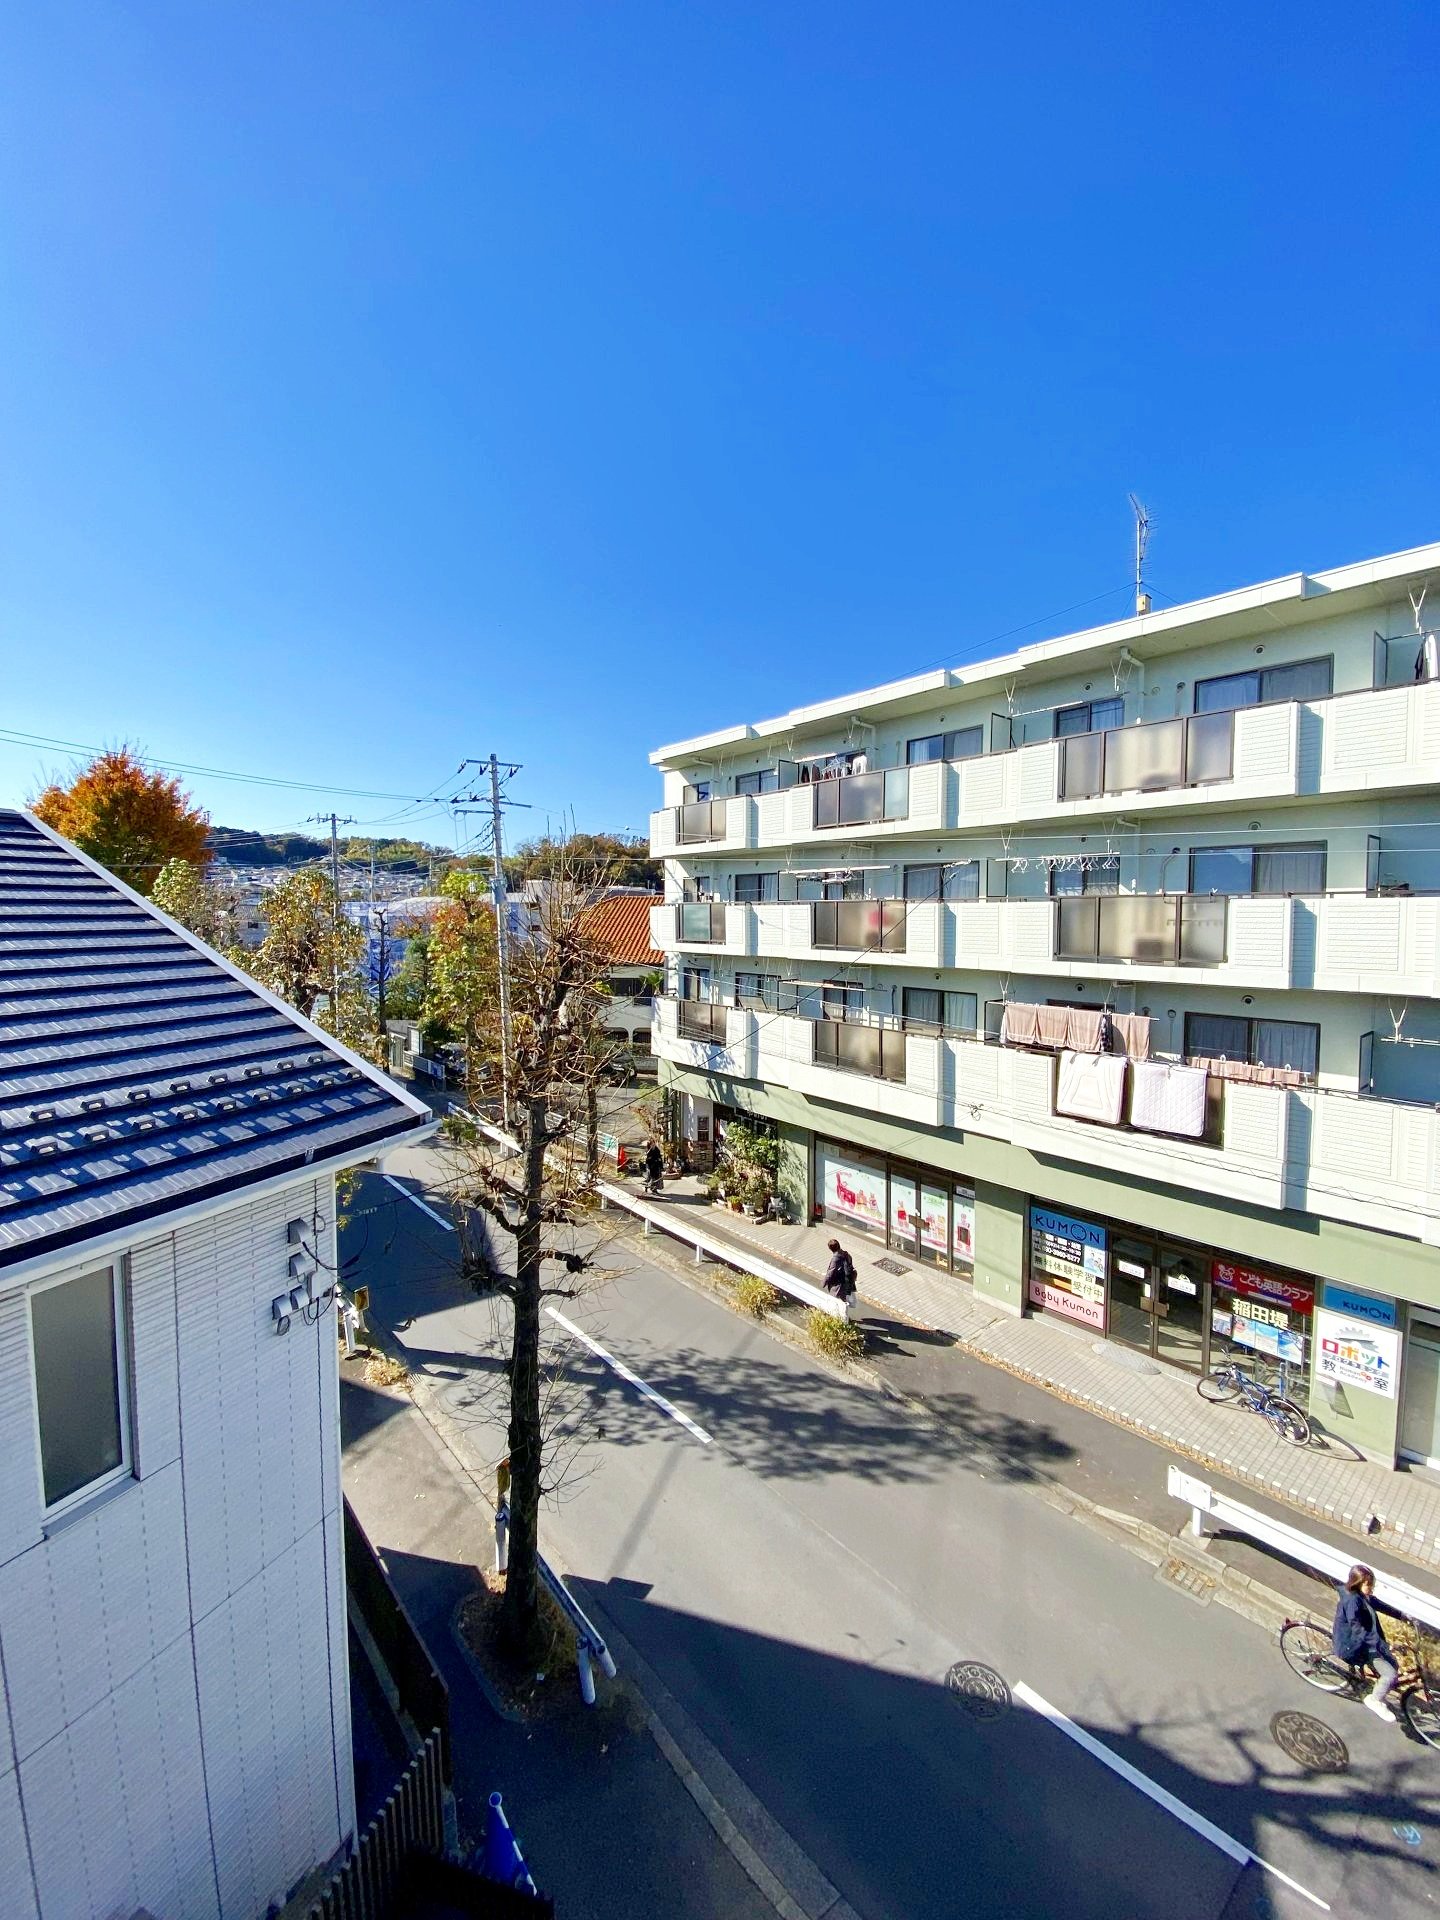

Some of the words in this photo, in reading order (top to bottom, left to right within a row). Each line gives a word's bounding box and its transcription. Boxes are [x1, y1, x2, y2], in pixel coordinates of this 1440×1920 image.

[1035, 1214, 1100, 1244] KUMON
[1034, 1255, 1095, 1284] 無料体験学習
[1073, 1280, 1103, 1299] 受付中
[1239, 1271, 1313, 1302] こども英語クラブ
[1034, 1286, 1060, 1306] Baby
[1062, 1296, 1099, 1319] Kumon
[1232, 1298, 1289, 1329] 稲田堤
[1342, 1300, 1391, 1321] KUMON
[1322, 1338, 1390, 1370] ロボット
